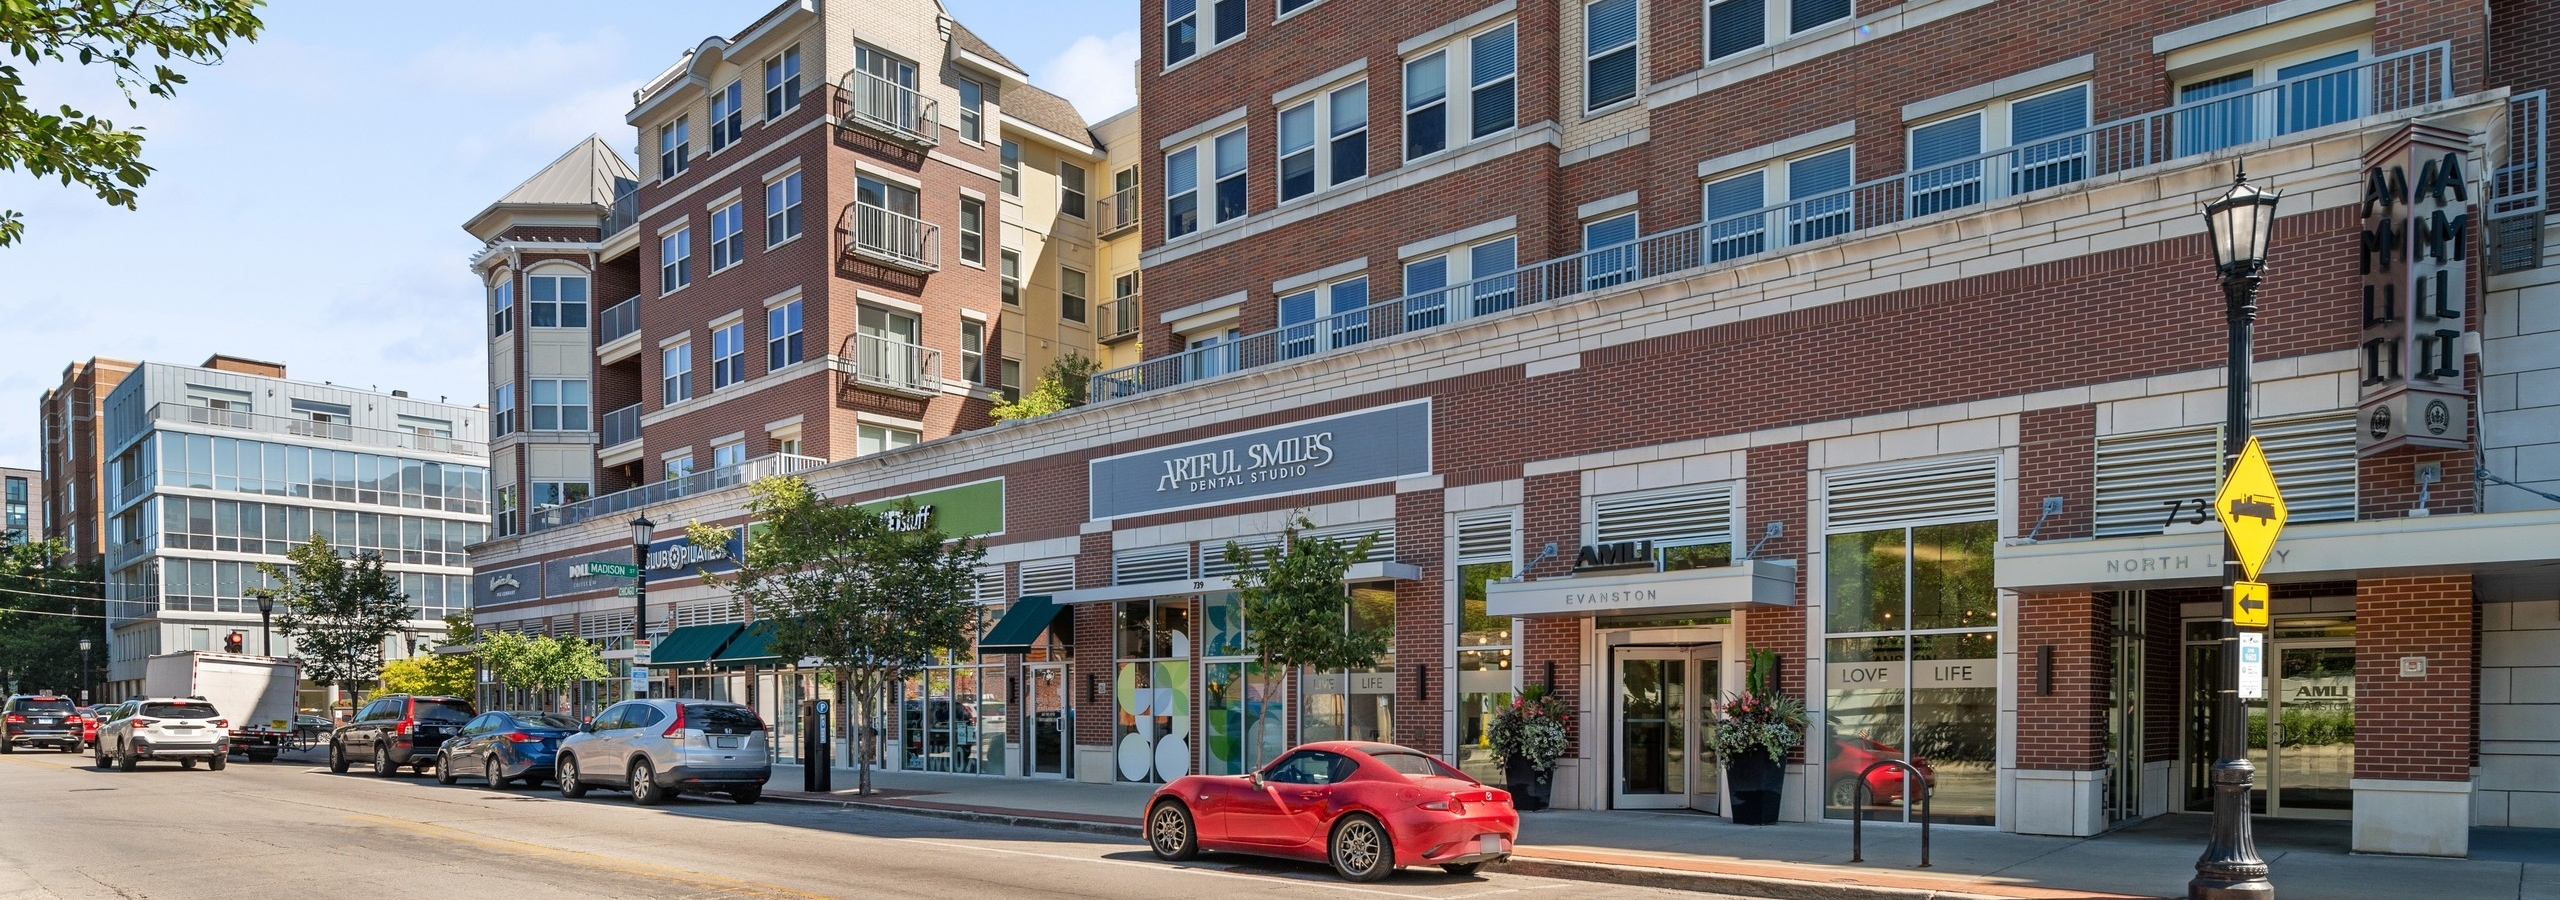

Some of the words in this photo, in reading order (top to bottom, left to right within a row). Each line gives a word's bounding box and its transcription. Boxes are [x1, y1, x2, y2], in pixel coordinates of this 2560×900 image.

[2432, 153, 2467, 377] AMLI
[2360, 167, 2392, 387] AMLI
[1157, 449, 1241, 491] ARTFUL
[1247, 432, 1333, 470] SMILES
[1190, 475, 1243, 492] DENTAL
[1251, 465, 1306, 483] STUDIO
[2163, 499, 2207, 527] 73
[645, 550, 668, 570] CLUB
[1574, 540, 1653, 568] AMLI
[569, 563, 594, 578] DOLL
[591, 563, 625, 575] MADISON
[2107, 556, 2189, 573] NORTH
[618, 587, 635, 597] CHICAGO
[1193, 581, 1204, 590] 739
[1566, 590, 1656, 605] EVANSTON
[1361, 677, 1383, 689] LIFE
[1842, 668, 1888, 683] LOVE
[1935, 666, 1973, 681] LIFE
[2295, 685, 2348, 697] AMLI
[2289, 702, 2351, 711] EVANSTON
